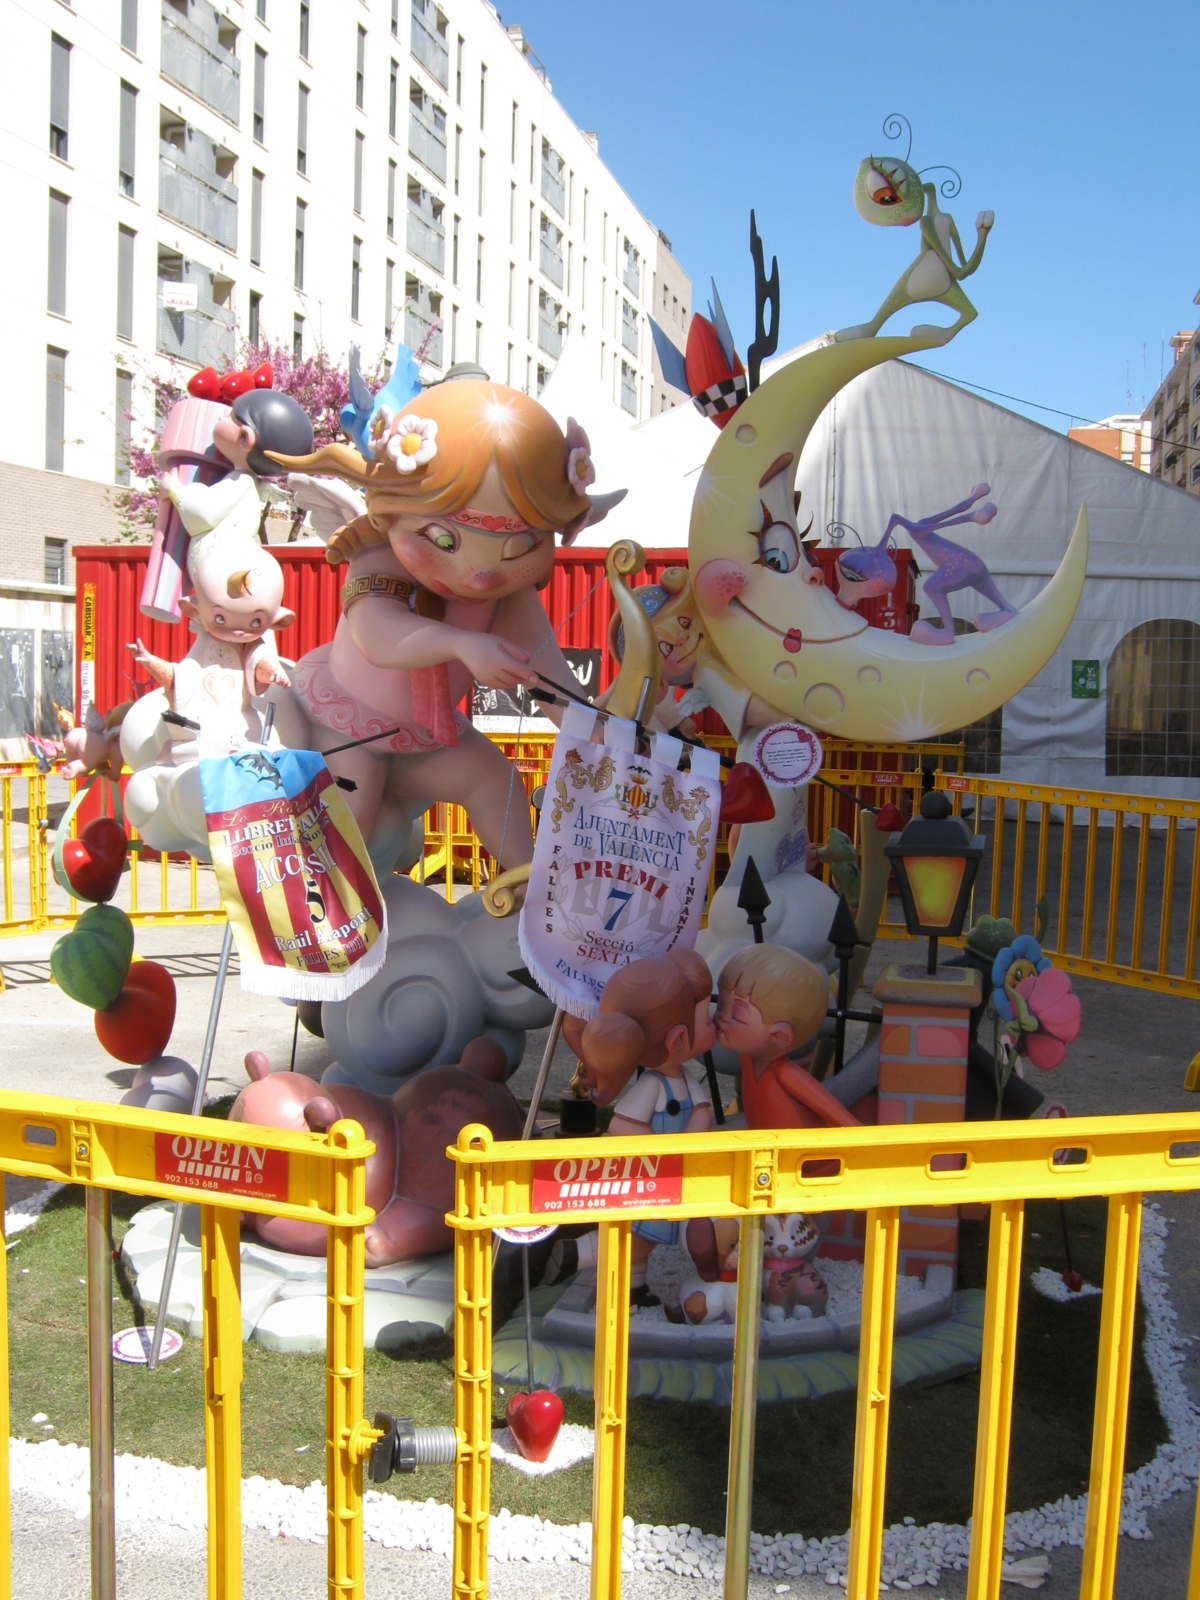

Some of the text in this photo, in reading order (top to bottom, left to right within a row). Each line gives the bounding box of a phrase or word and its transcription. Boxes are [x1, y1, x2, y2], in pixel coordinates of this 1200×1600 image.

[221, 809, 247, 828] Lo
[223, 797, 330, 848] LLIBRET ALLA
[573, 805, 686, 856] AJUNTAMENT
[232, 839, 273, 858] Secció
[573, 832, 681, 872] DE VALÈNCIA
[545, 844, 562, 934] FALLES
[573, 860, 670, 901] PREMI
[304, 879, 327, 924] 5
[604, 886, 635, 931] 7
[273, 905, 374, 952] Raül Alapont
[583, 930, 634, 953] Secció
[296, 948, 340, 968] FALLES
[341, 932, 370, 956] 2014
[576, 944, 632, 968] SEXTA
[555, 958, 606, 993] FALLES
[171, 1134, 268, 1171] OPEIN
[553, 1155, 662, 1183] OPEIN
[164, 1173, 277, 1199] 902 153 688 www.opein.com
[544, 1197, 671, 1210] 902 153 688 www.opein.com
